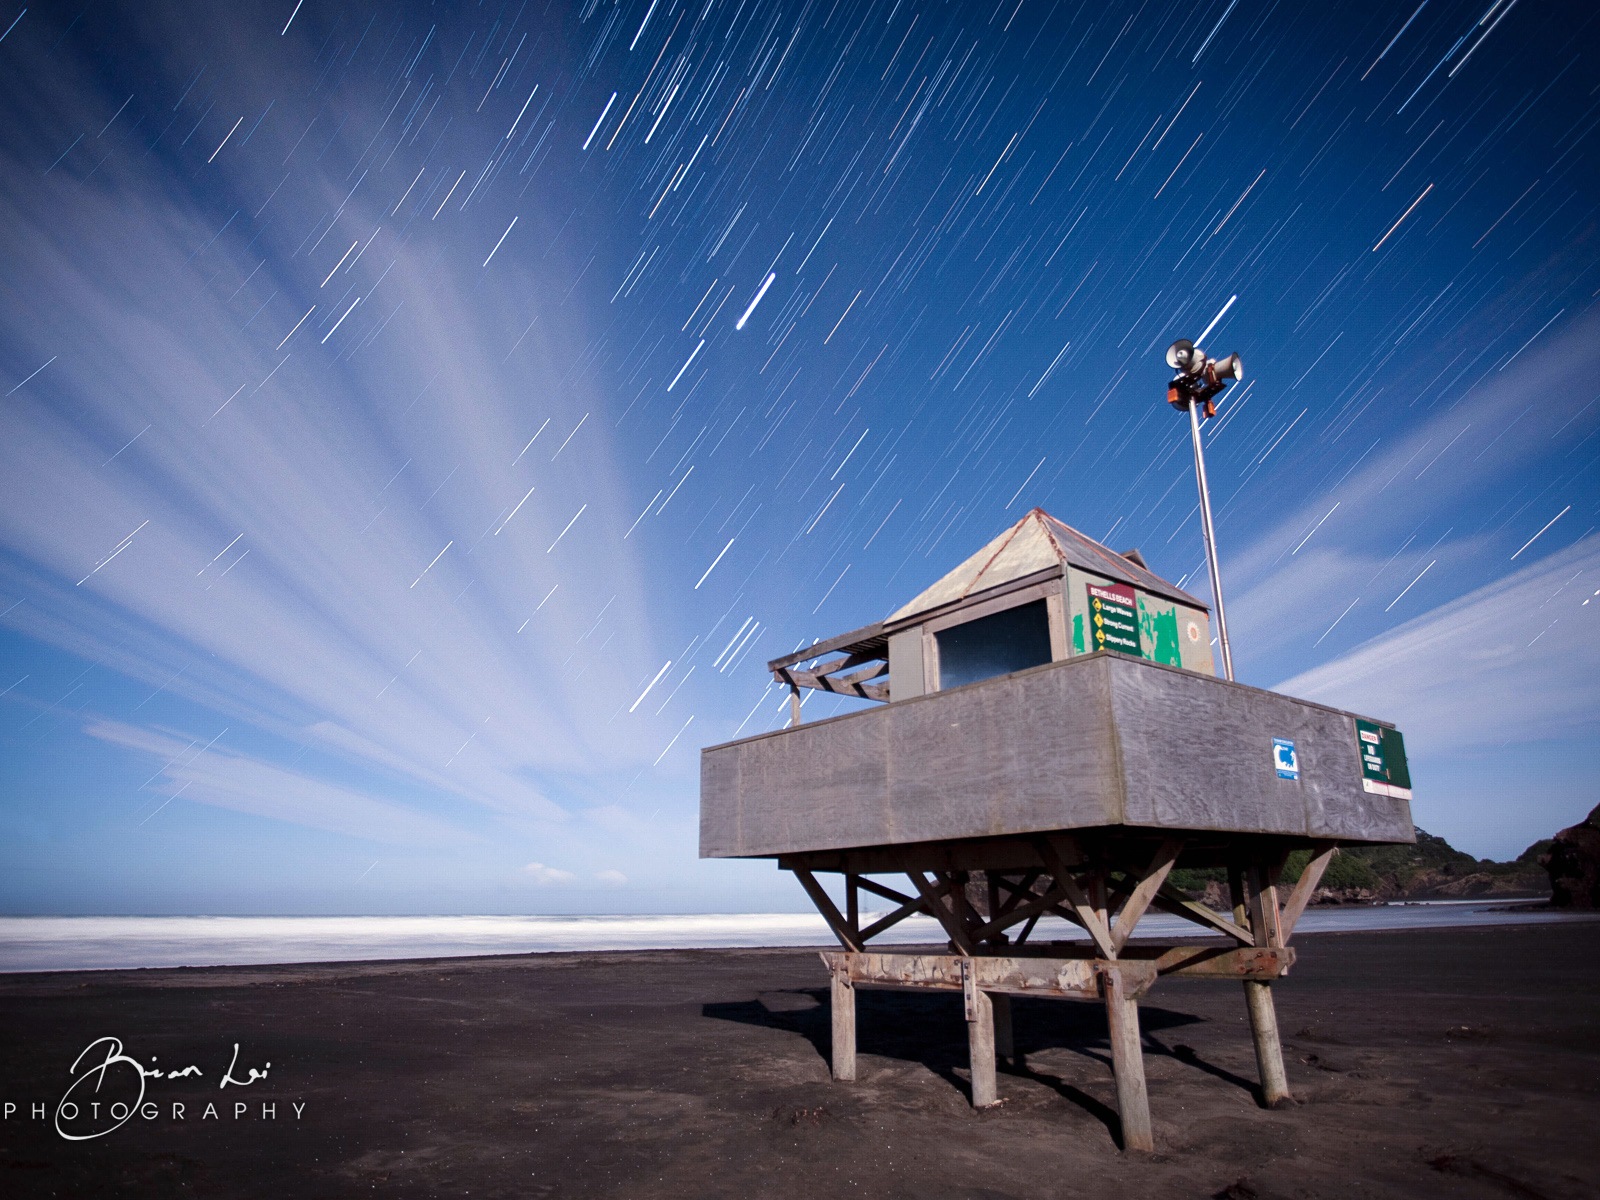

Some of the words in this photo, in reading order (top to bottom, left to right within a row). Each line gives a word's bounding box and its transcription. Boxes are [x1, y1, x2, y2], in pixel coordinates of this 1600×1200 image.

[1091, 587, 1116, 601] BETHELLS
[1115, 595, 1132, 606] BEACH
[1102, 603, 1116, 613] Large
[1116, 607, 1133, 617] Waves
[1104, 618, 1118, 629] Strong
[1105, 633, 1123, 645] Slippery
[1361, 732, 1377, 742] DANGER
